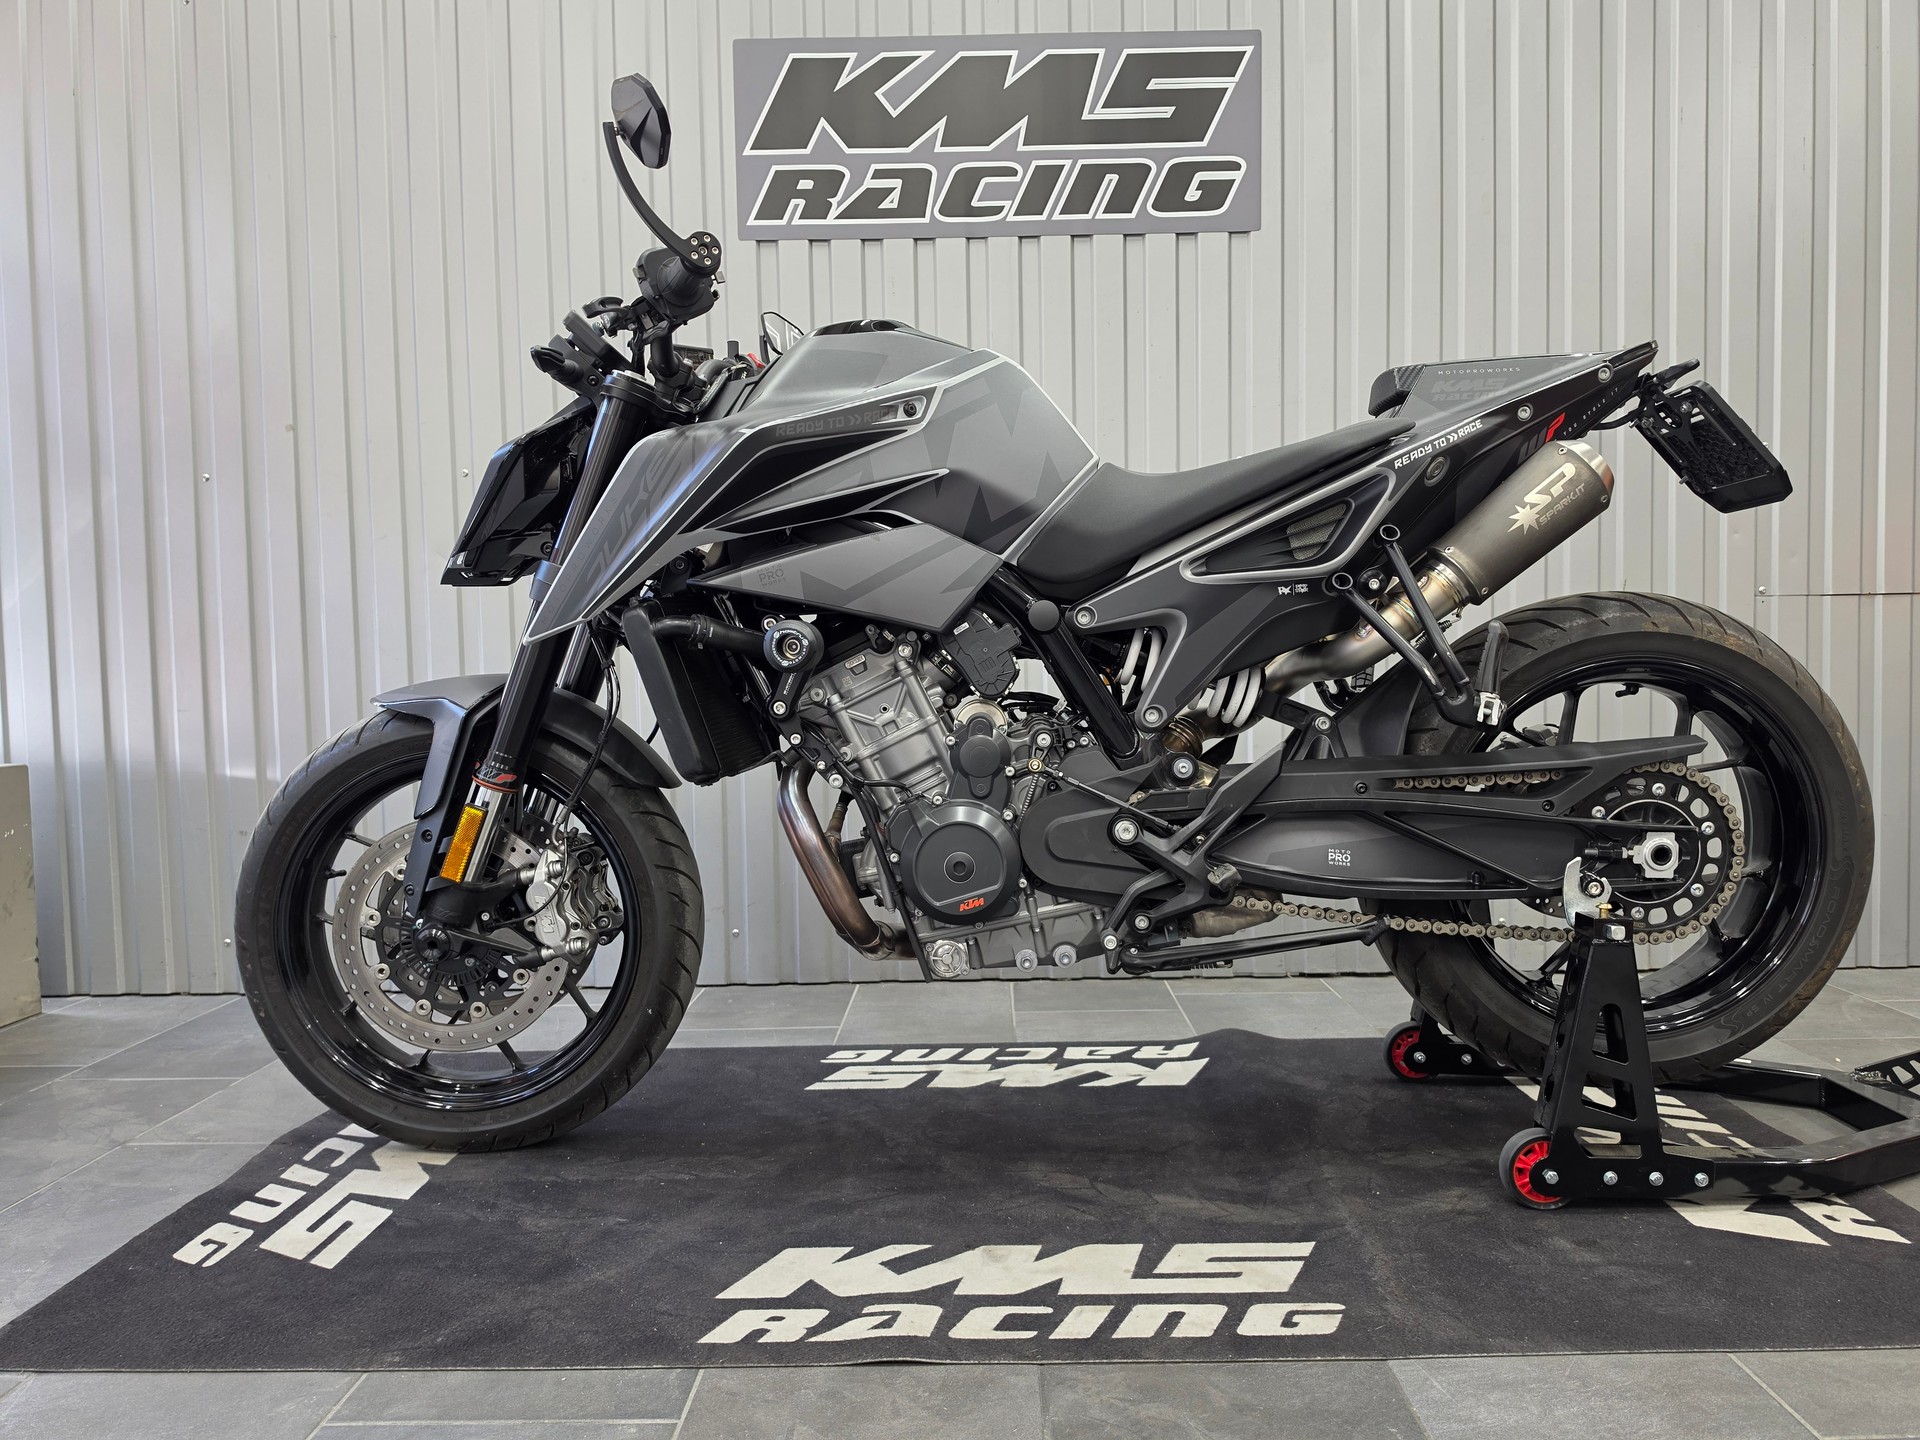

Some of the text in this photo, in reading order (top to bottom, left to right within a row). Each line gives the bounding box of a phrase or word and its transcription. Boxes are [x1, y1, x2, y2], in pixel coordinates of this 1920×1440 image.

[742, 46, 1254, 155] KMS
[746, 155, 1247, 226] RACING
[1438, 367, 1520, 375] MOTOPROWORKS
[776, 421, 823, 437] READY
[829, 416, 844, 429] TO
[1394, 419, 1483, 470] READY TO RACE
[758, 568, 784, 583] PRO
[1328, 852, 1351, 862] PRO
[959, 897, 985, 912] KTM
[715, 1241, 1317, 1299] KMS
